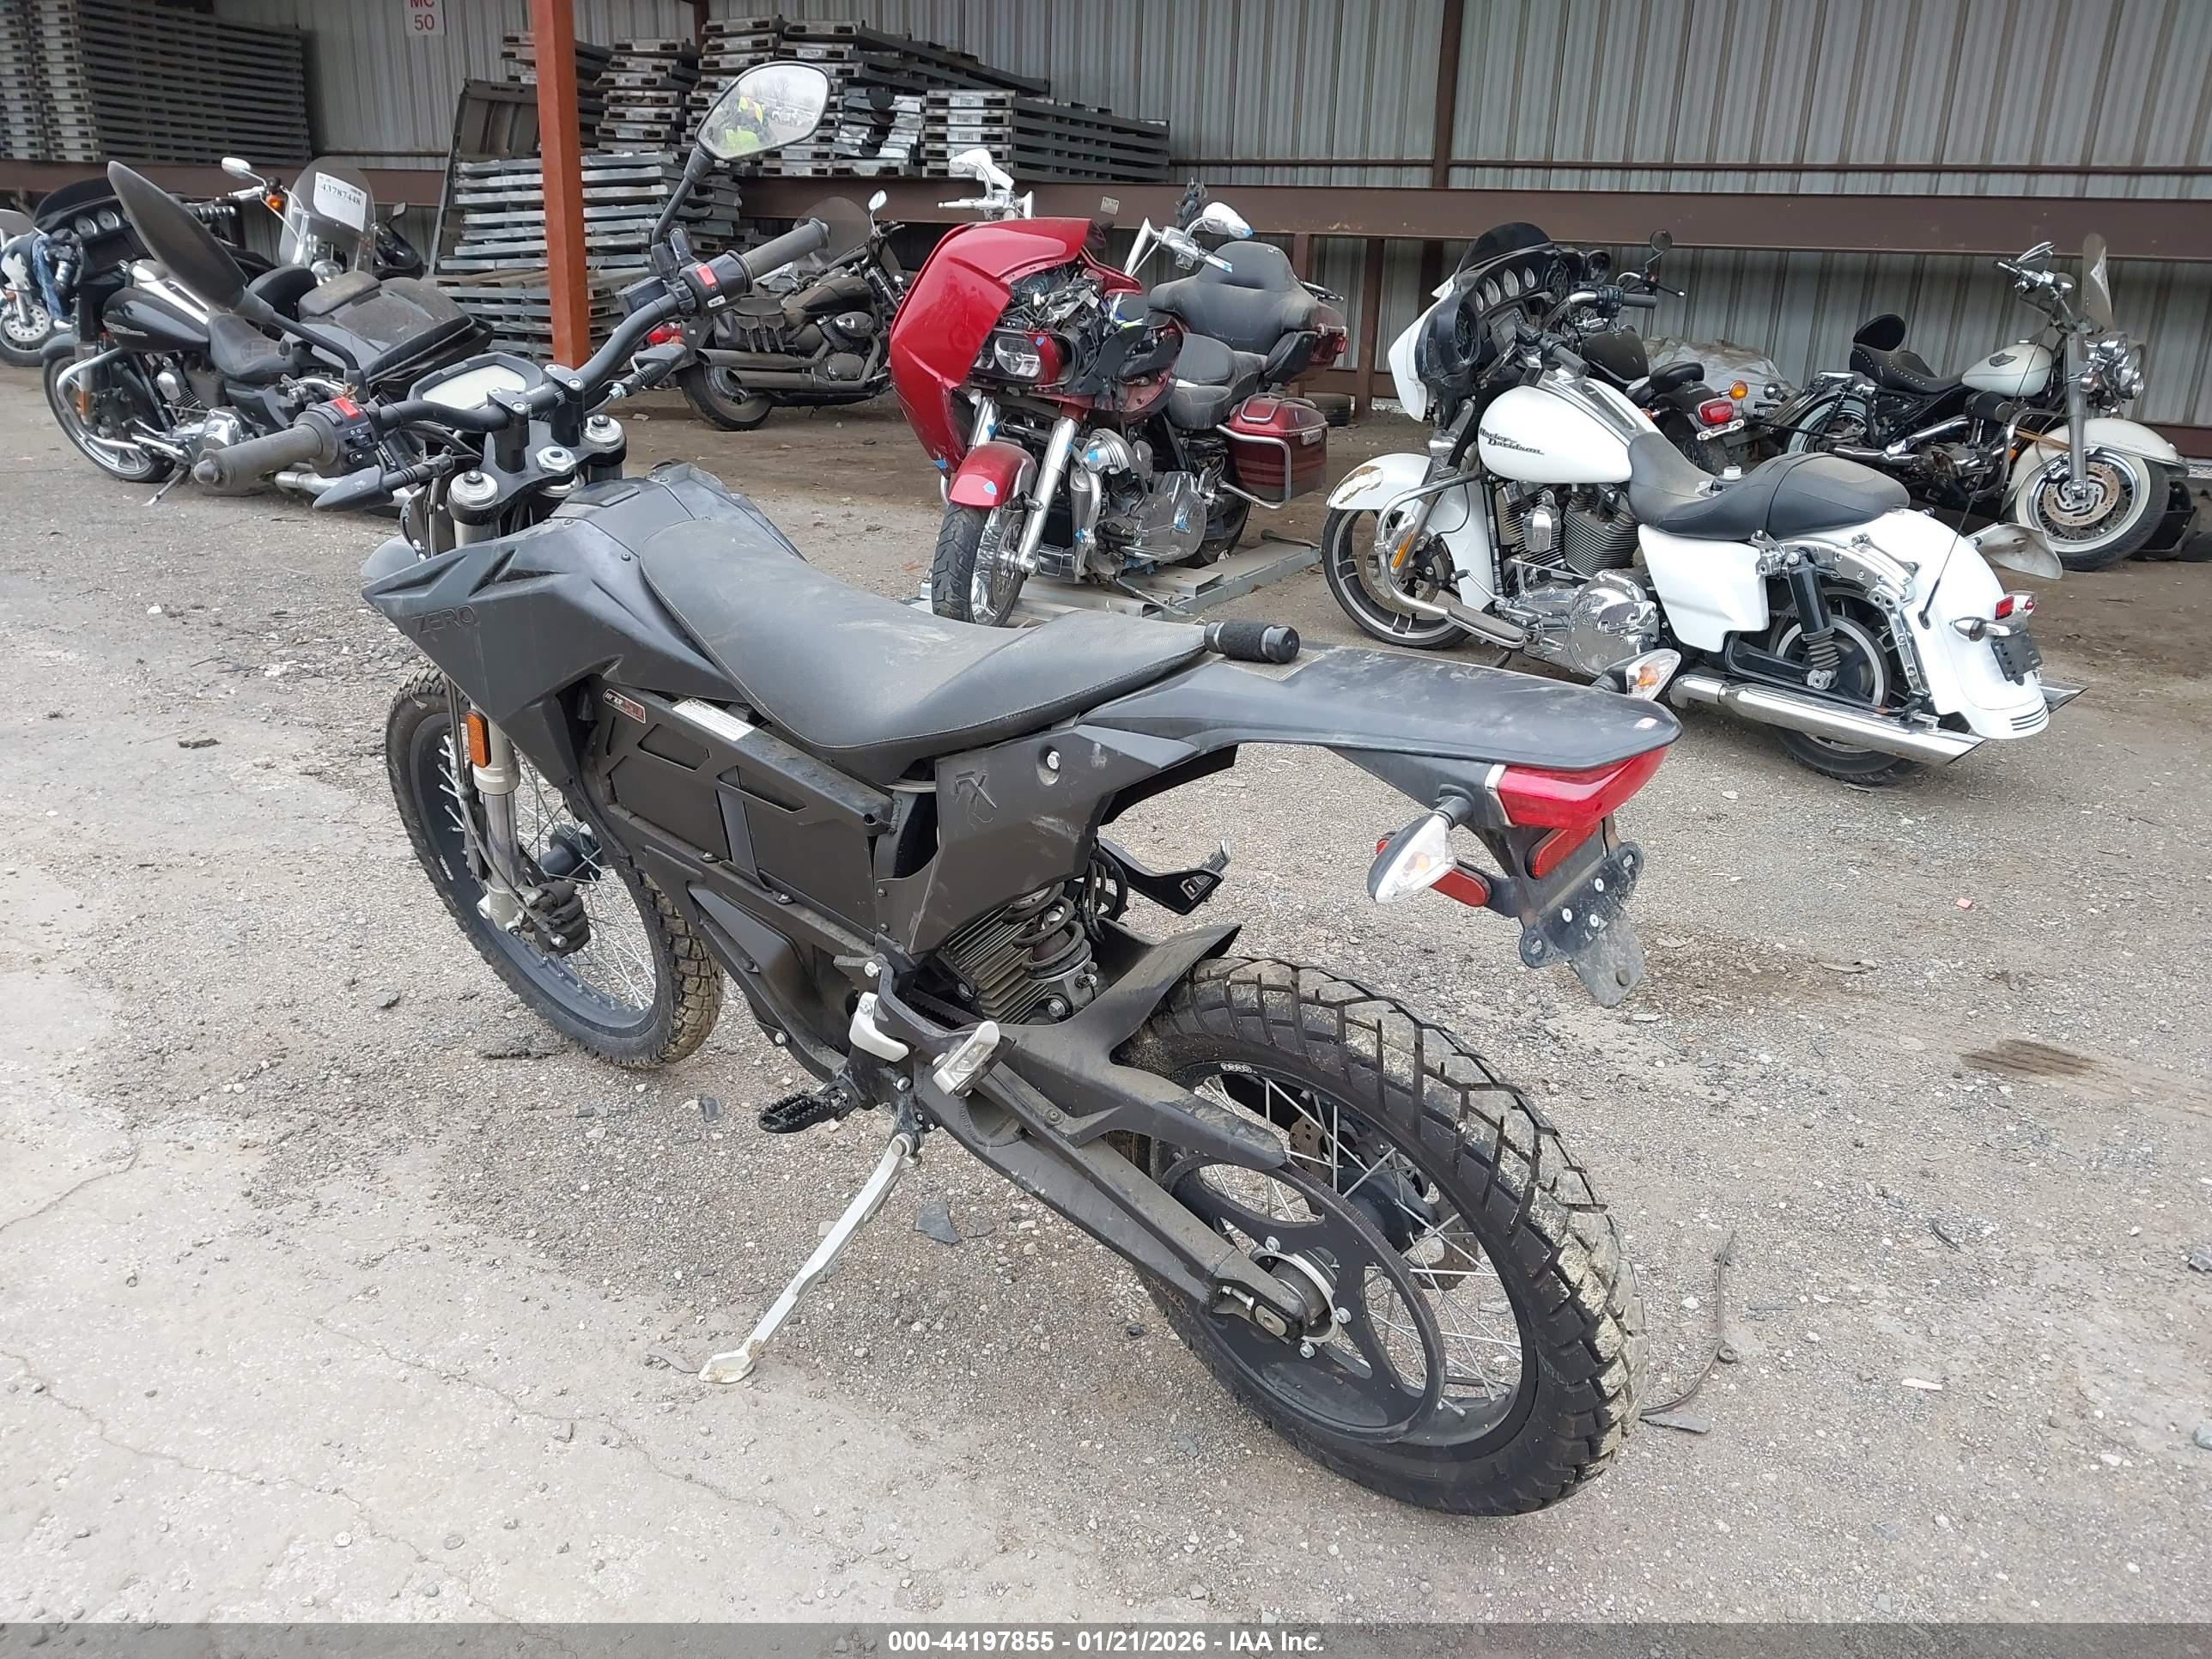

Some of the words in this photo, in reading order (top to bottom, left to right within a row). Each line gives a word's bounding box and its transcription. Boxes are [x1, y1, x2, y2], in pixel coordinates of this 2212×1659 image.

[414, 14, 434, 31] 50
[1479, 427, 1517, 443] Harley
[1487, 438, 1545, 455] Davidson
[410, 605, 476, 634] ZERO
